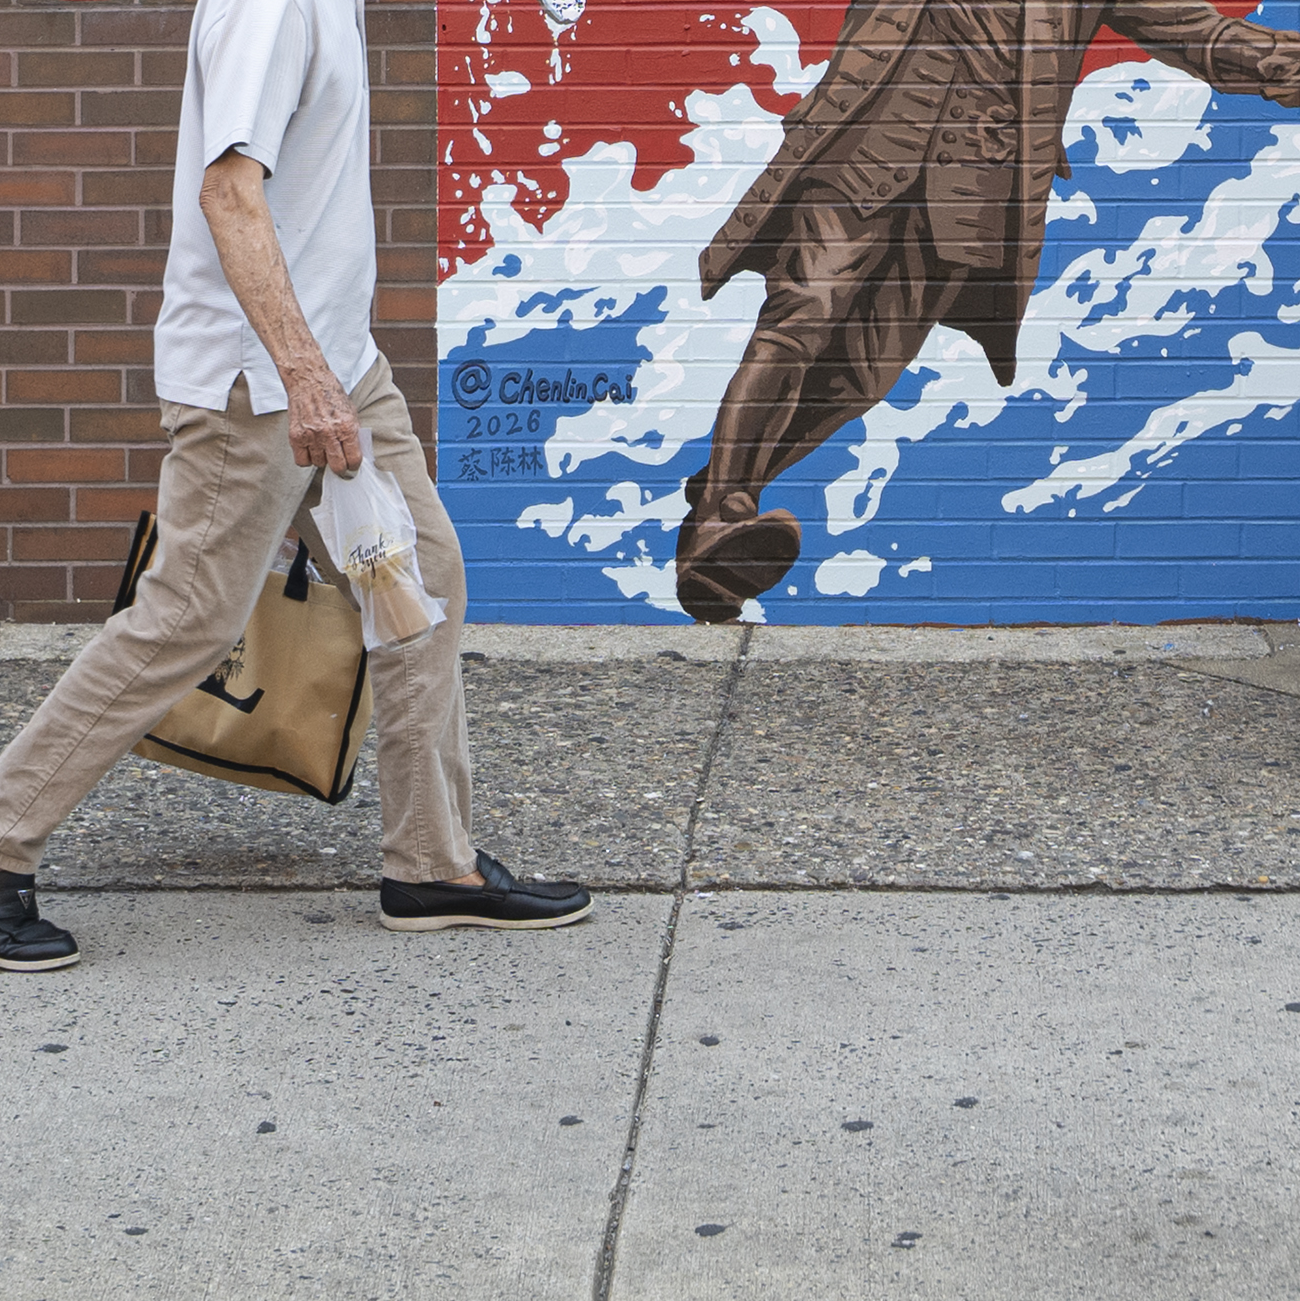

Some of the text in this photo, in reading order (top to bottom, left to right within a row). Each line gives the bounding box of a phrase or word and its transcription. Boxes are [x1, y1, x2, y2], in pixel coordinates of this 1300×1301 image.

[466, 409, 541, 439] 2026
[457, 446, 544, 481] 蔡陈林
[348, 532, 394, 570] Thank
[361, 550, 387, 580] you
